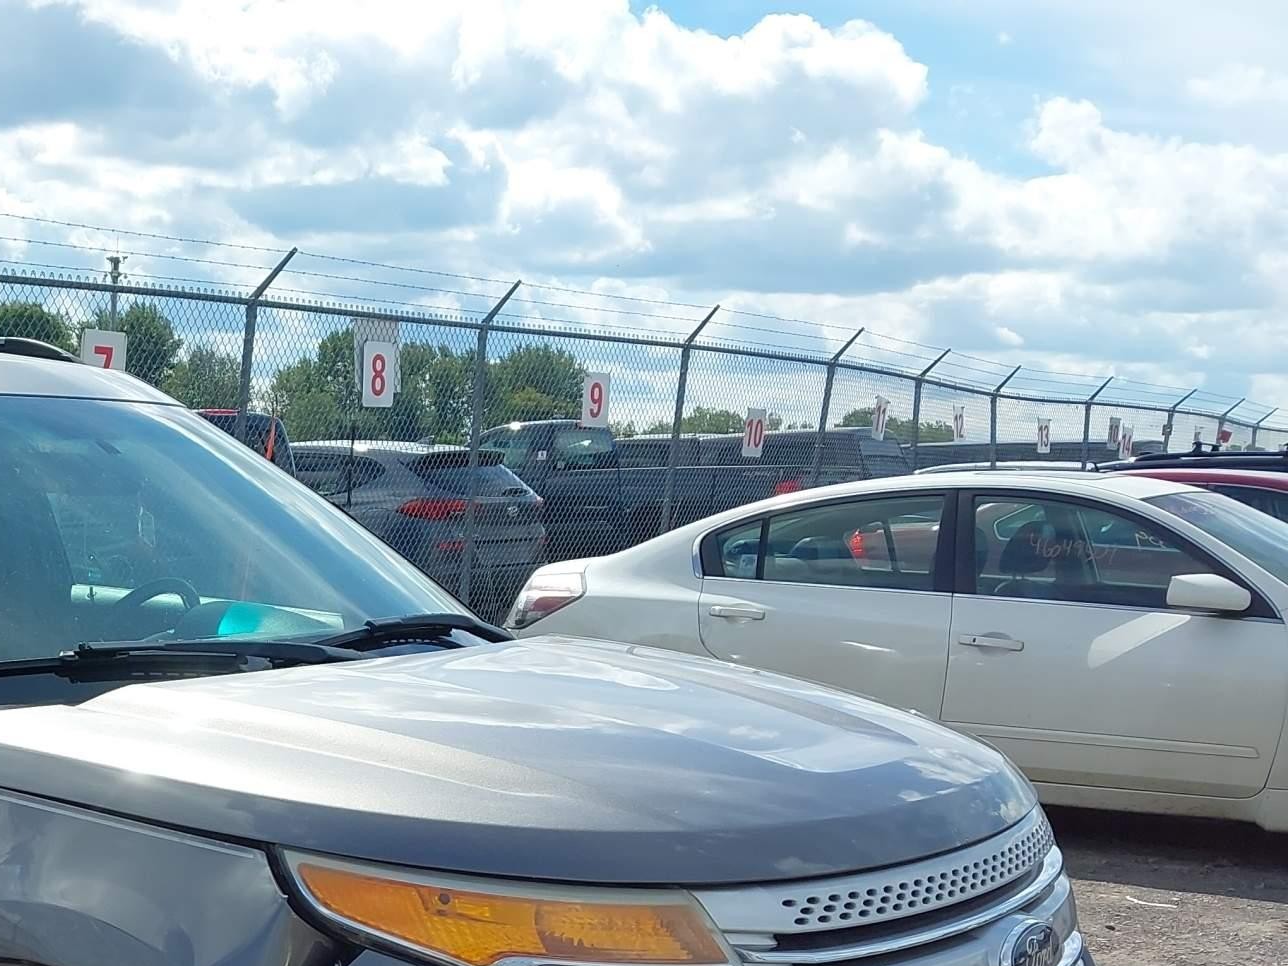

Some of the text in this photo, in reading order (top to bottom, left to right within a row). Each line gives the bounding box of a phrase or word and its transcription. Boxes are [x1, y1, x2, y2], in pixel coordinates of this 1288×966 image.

[94, 345, 114, 369] 7
[371, 353, 386, 397] 8
[589, 382, 603, 418] 9
[746, 418, 764, 448] 10
[876, 404, 887, 434] 11
[953, 413, 964, 439] 12
[1038, 425, 1049, 448] 13
[1121, 433, 1133, 457] 14
